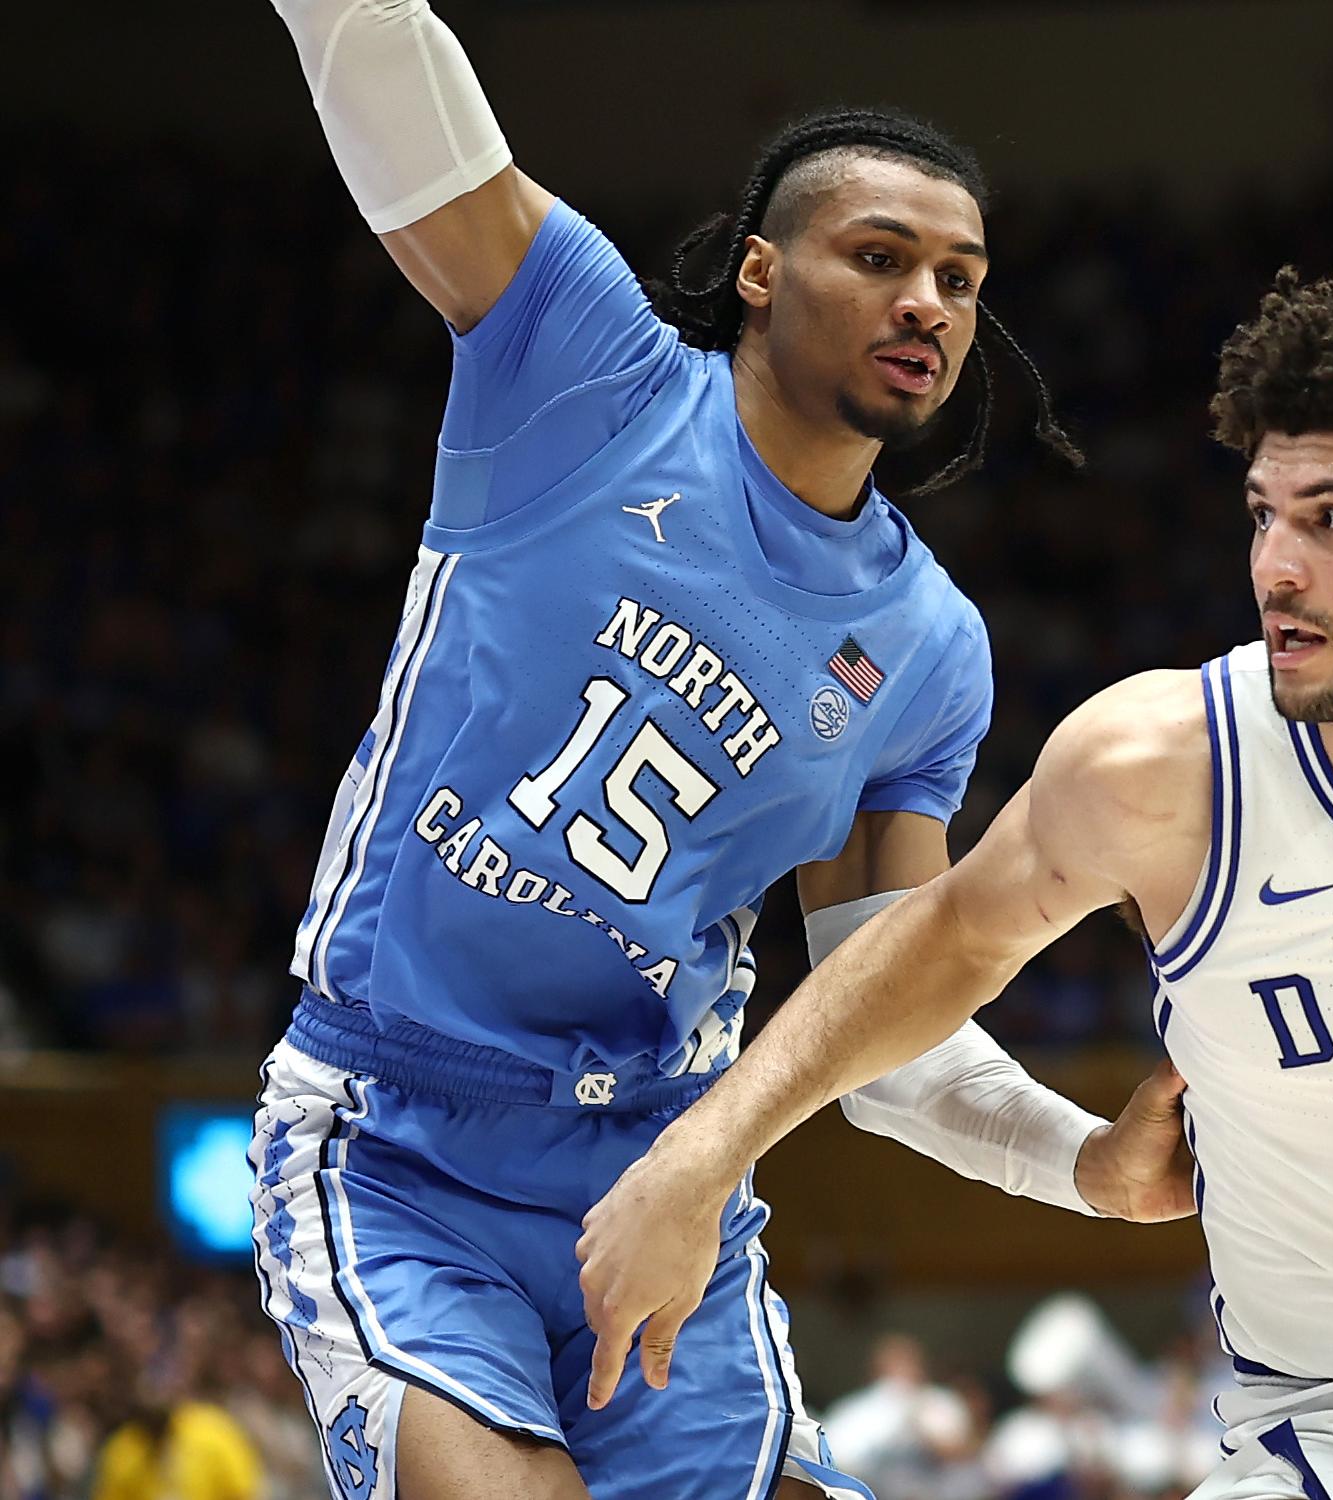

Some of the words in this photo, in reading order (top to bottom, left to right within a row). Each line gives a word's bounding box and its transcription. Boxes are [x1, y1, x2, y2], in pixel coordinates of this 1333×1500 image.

[506, 675, 722, 905] 15
[594, 596, 783, 780] NORTH
[414, 787, 679, 999] CAROLINA
